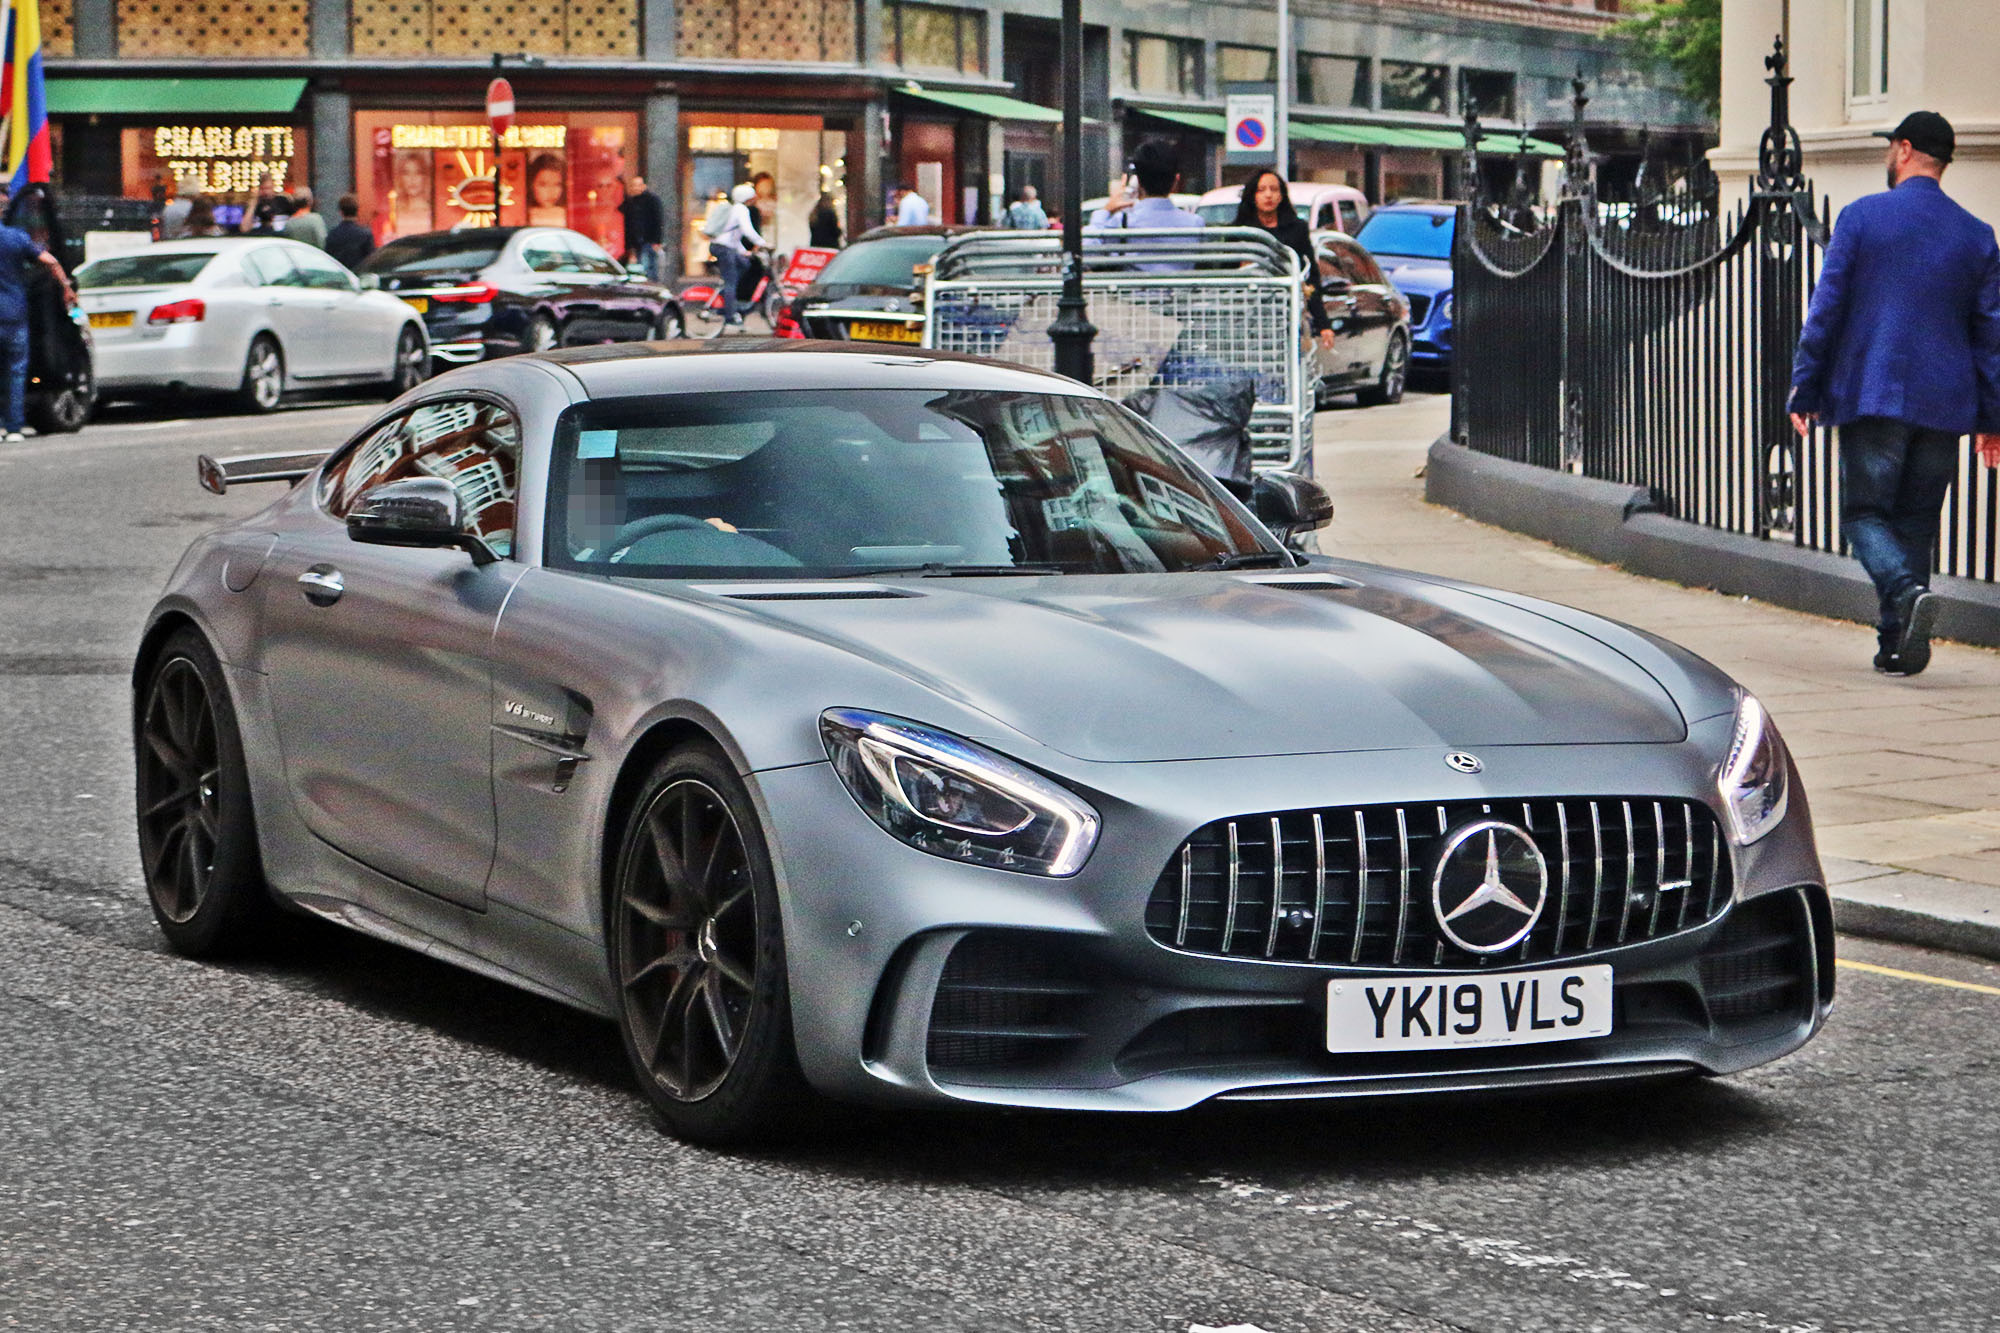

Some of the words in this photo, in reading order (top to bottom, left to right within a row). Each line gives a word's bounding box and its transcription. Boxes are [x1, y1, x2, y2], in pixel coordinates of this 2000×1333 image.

[505, 700, 524, 715] V8
[1365, 984, 1482, 1038] YK19
[1500, 975, 1585, 1032] VLS
